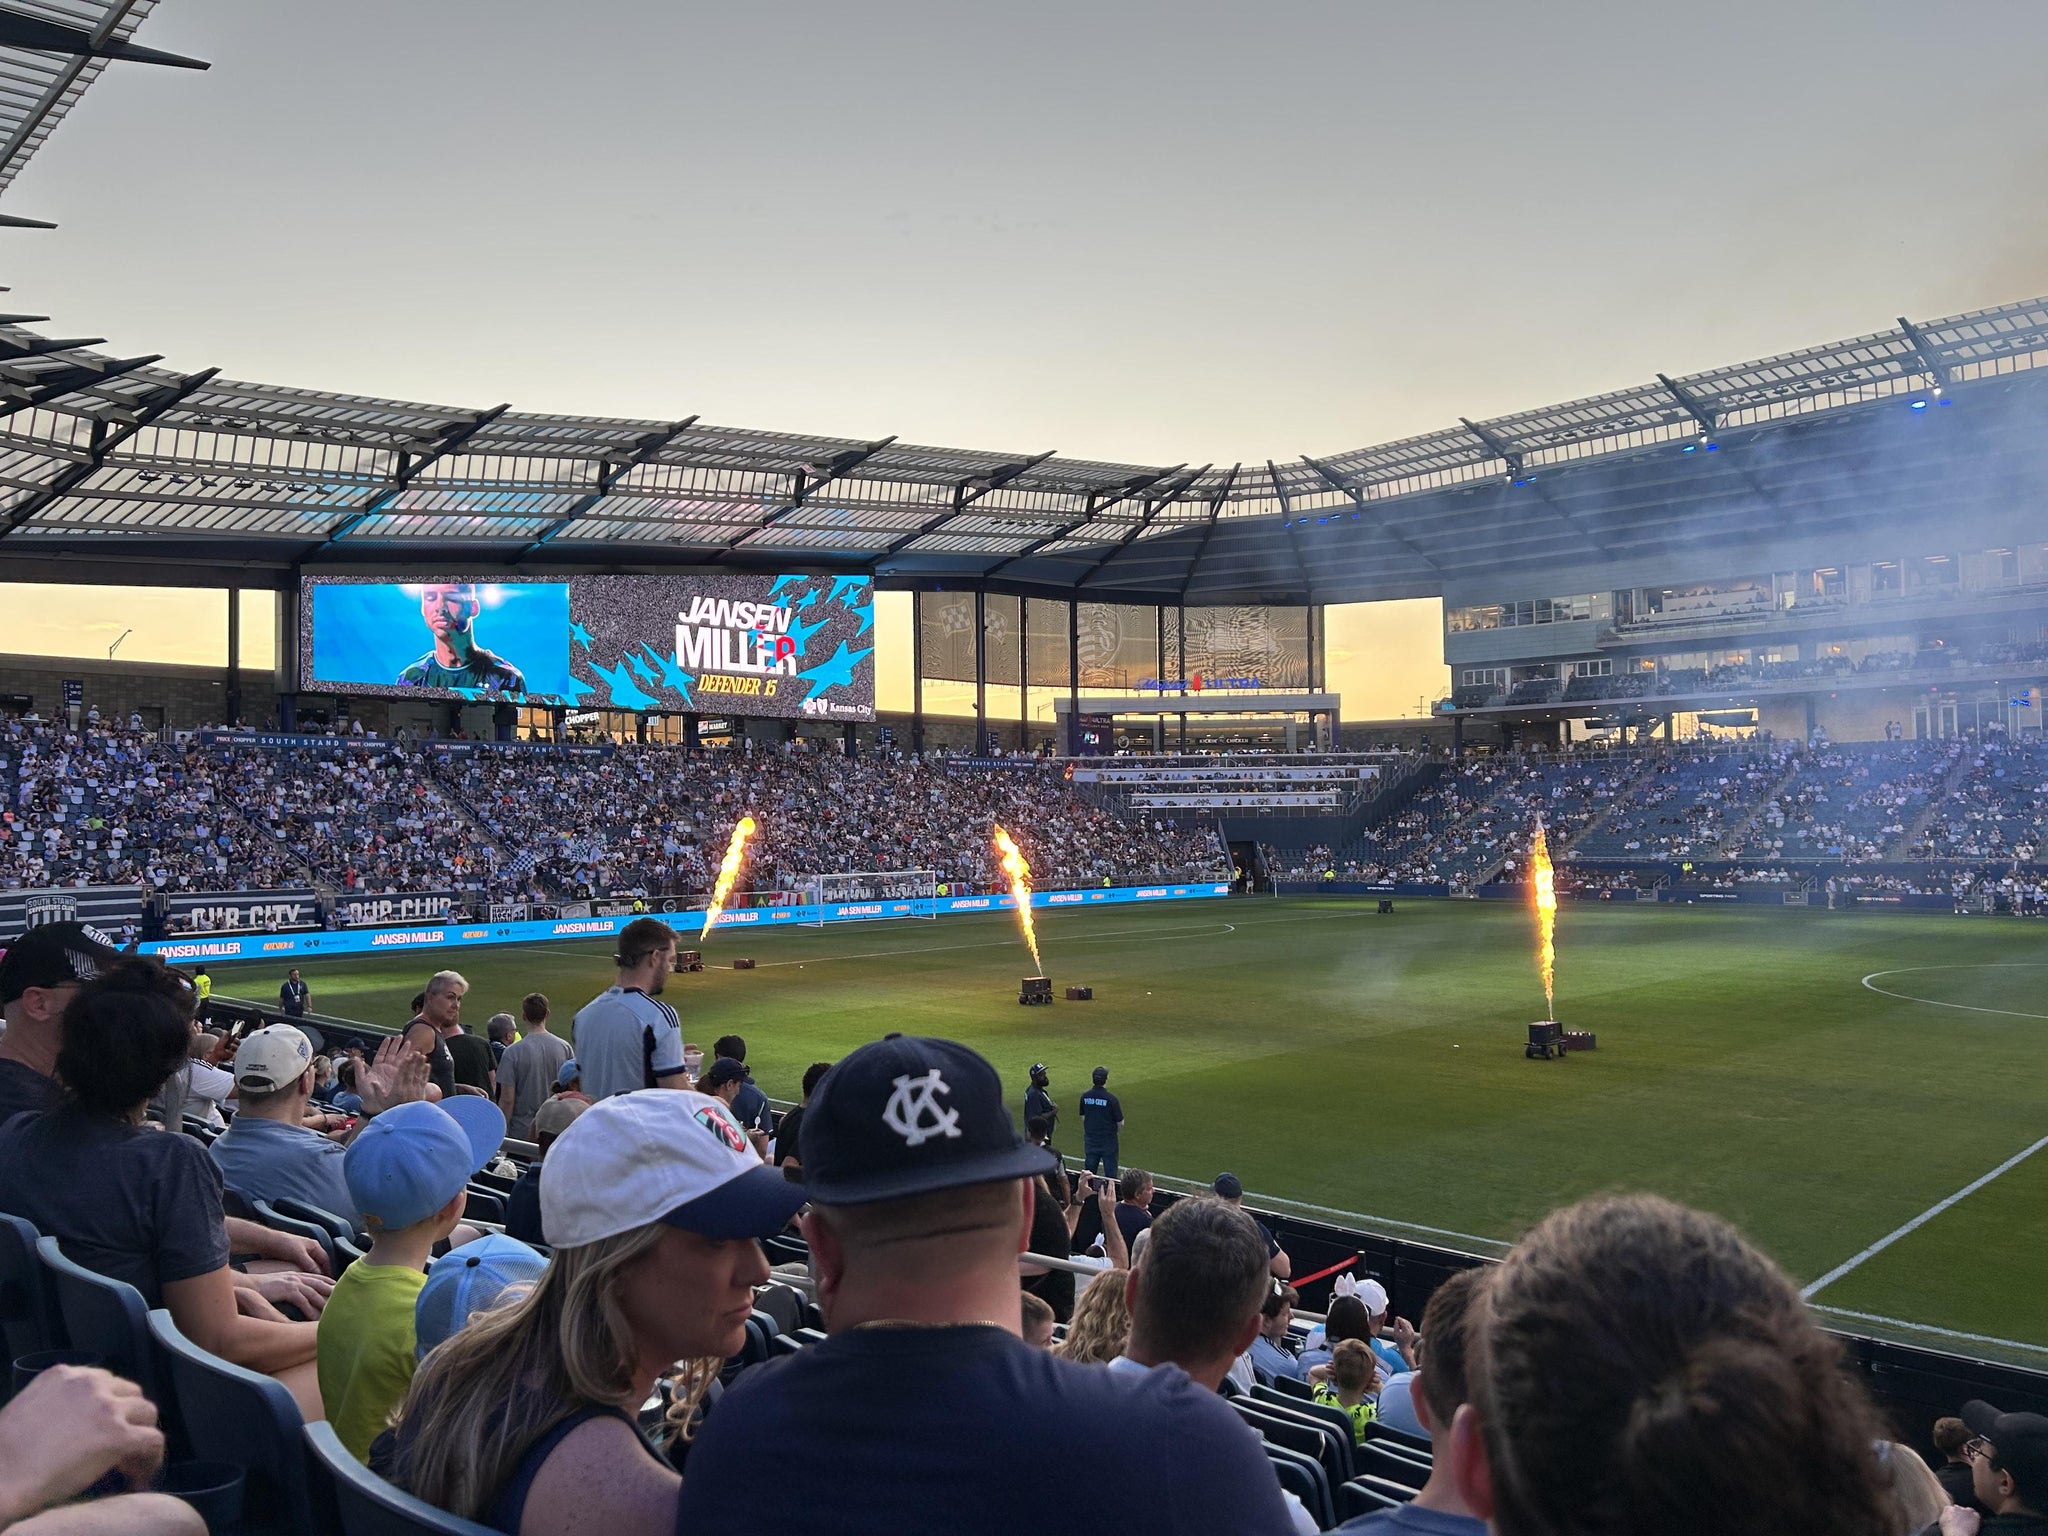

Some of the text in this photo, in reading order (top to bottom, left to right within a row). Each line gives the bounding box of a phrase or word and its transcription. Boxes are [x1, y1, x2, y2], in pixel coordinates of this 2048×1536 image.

[678, 596, 792, 633] JANSEN
[675, 624, 797, 675] MILLER
[697, 673, 778, 696] DEFENDER 15
[829, 703, 872, 716] Kansas City
[564, 711, 600, 725] CHOPPER
[261, 737, 297, 746] SOUTH
[303, 739, 340, 747] STAND
[28, 897, 75, 908] SOUTH STAND
[950, 900, 971, 909] JANSEN
[971, 899, 990, 907] MILLER
[249, 904, 301, 929] CITY
[735, 912, 759, 922] MILLER
[837, 906, 861, 916] JANSEN
[861, 905, 882, 914] MILLER
[552, 921, 615, 935] JANSEN MILLER
[371, 931, 444, 946] JANSEN MILLER
[202, 942, 241, 956] MILLER
